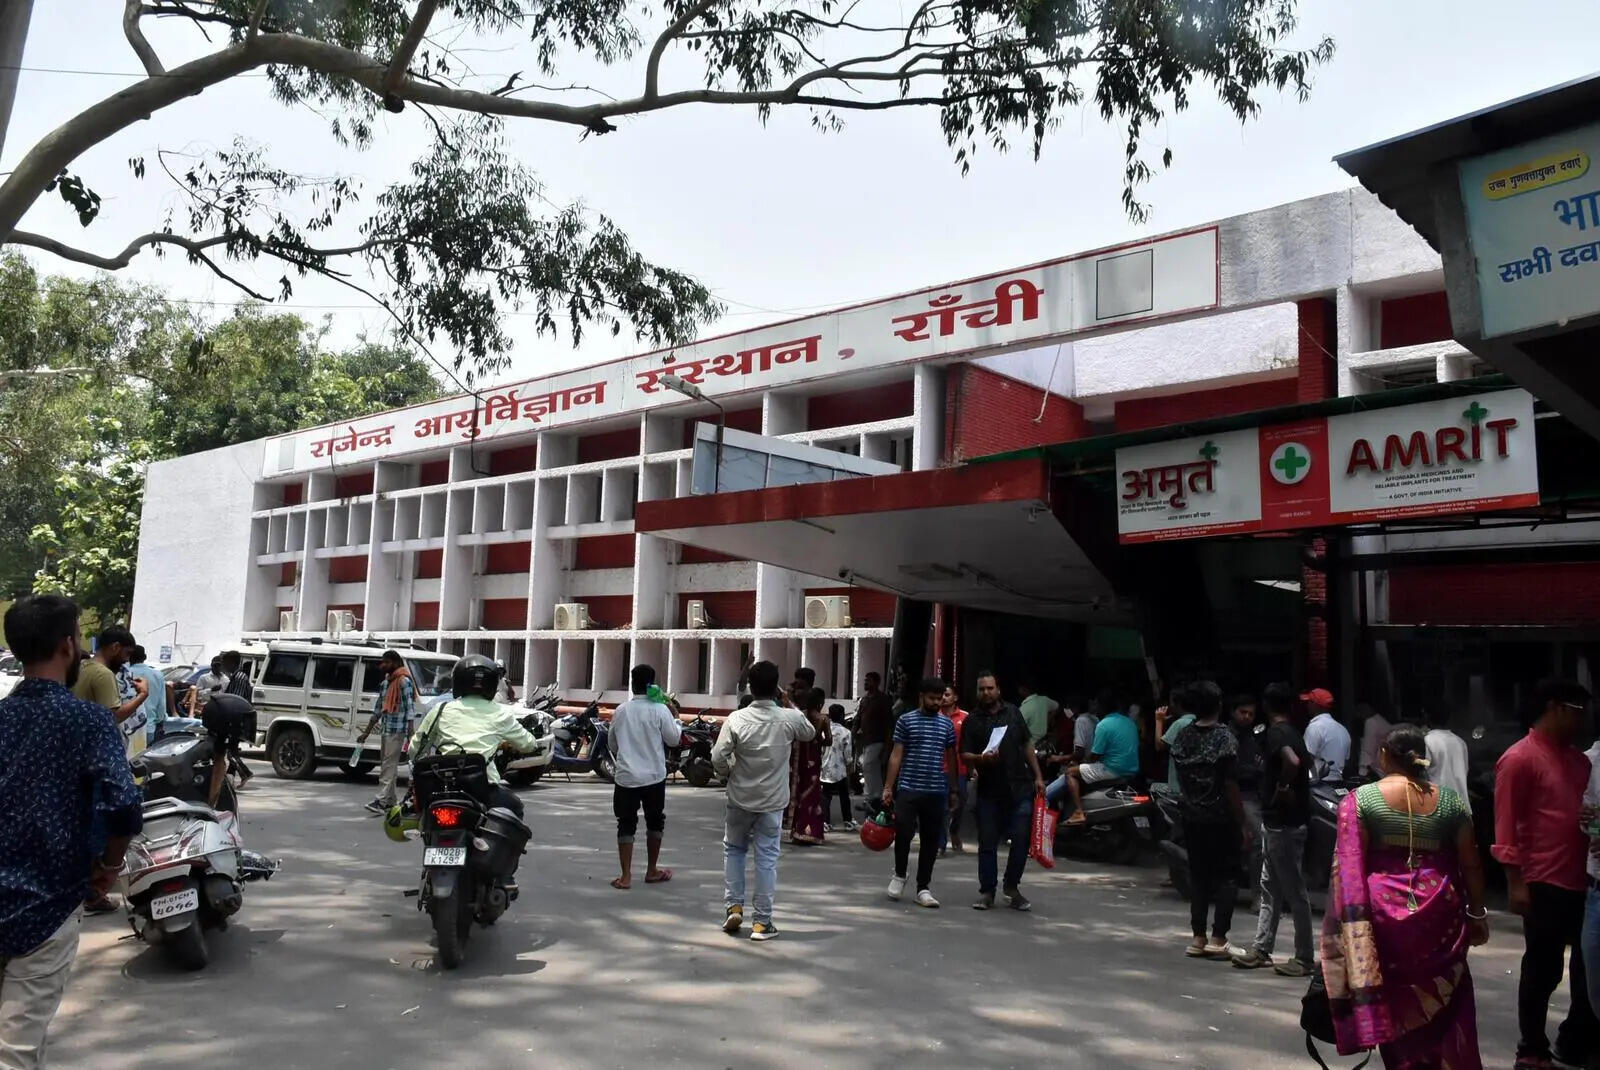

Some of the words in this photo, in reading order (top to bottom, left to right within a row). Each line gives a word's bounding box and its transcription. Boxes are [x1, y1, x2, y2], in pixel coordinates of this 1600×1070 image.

[1499, 246, 1553, 284] सभी
[1558, 241, 1600, 267] दव
[310, 426, 395, 457] राजेन्द्र
[414, 381, 607, 438] आयुर्विज्ञान
[1347, 417, 1518, 475] AMRIT
[1121, 459, 1218, 509] अमृत
[1385, 473, 1420, 482] AFFORDABLE
[1421, 470, 1451, 479] MEDICINES
[1401, 478, 1429, 486] IMPLANTS
[1441, 473, 1476, 482] TREATMENT
[1418, 489, 1433, 497] INDIA
[1434, 487, 1463, 495] INITIATIVE
[156, 900, 194, 915] 4096
